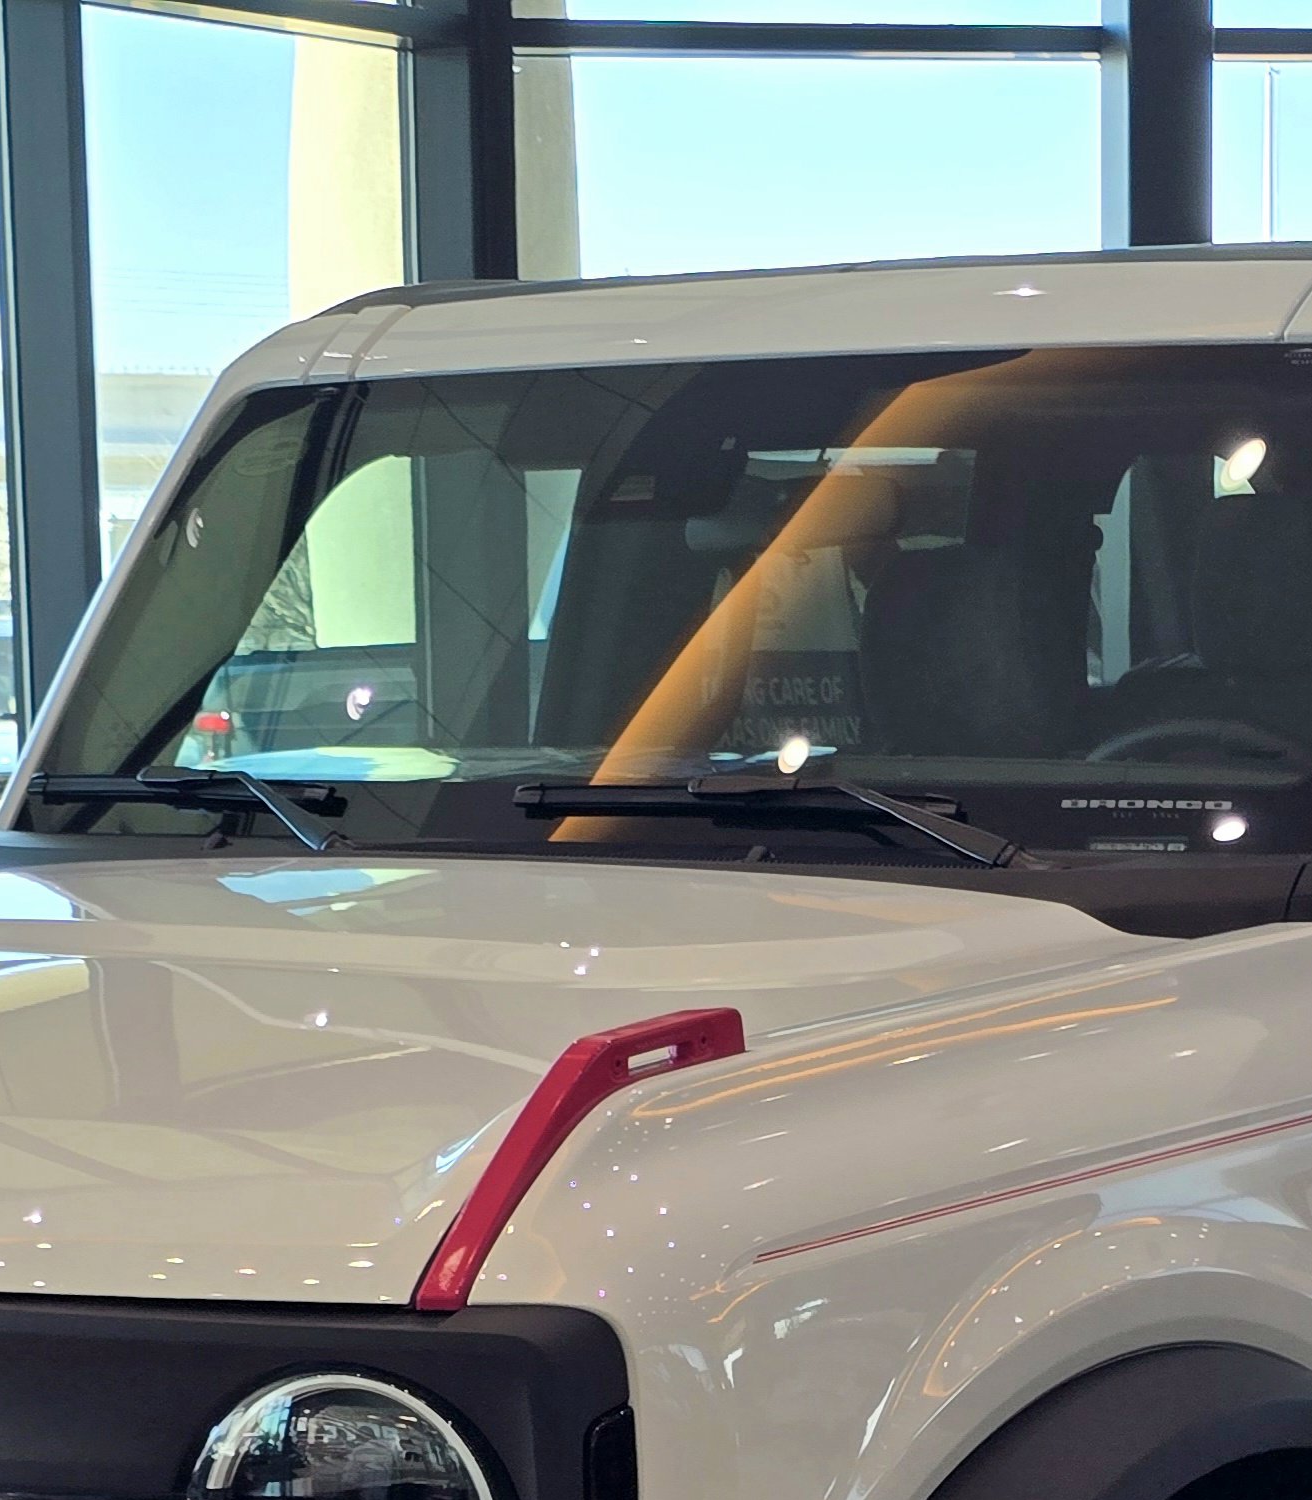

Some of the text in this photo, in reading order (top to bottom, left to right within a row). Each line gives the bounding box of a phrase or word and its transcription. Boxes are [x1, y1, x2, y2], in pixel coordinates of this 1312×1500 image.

[769, 675, 818, 705] CARE
[820, 675, 844, 704] OF
[800, 714, 862, 746] FAMILY
[1061, 799, 1233, 810] BRONCO
